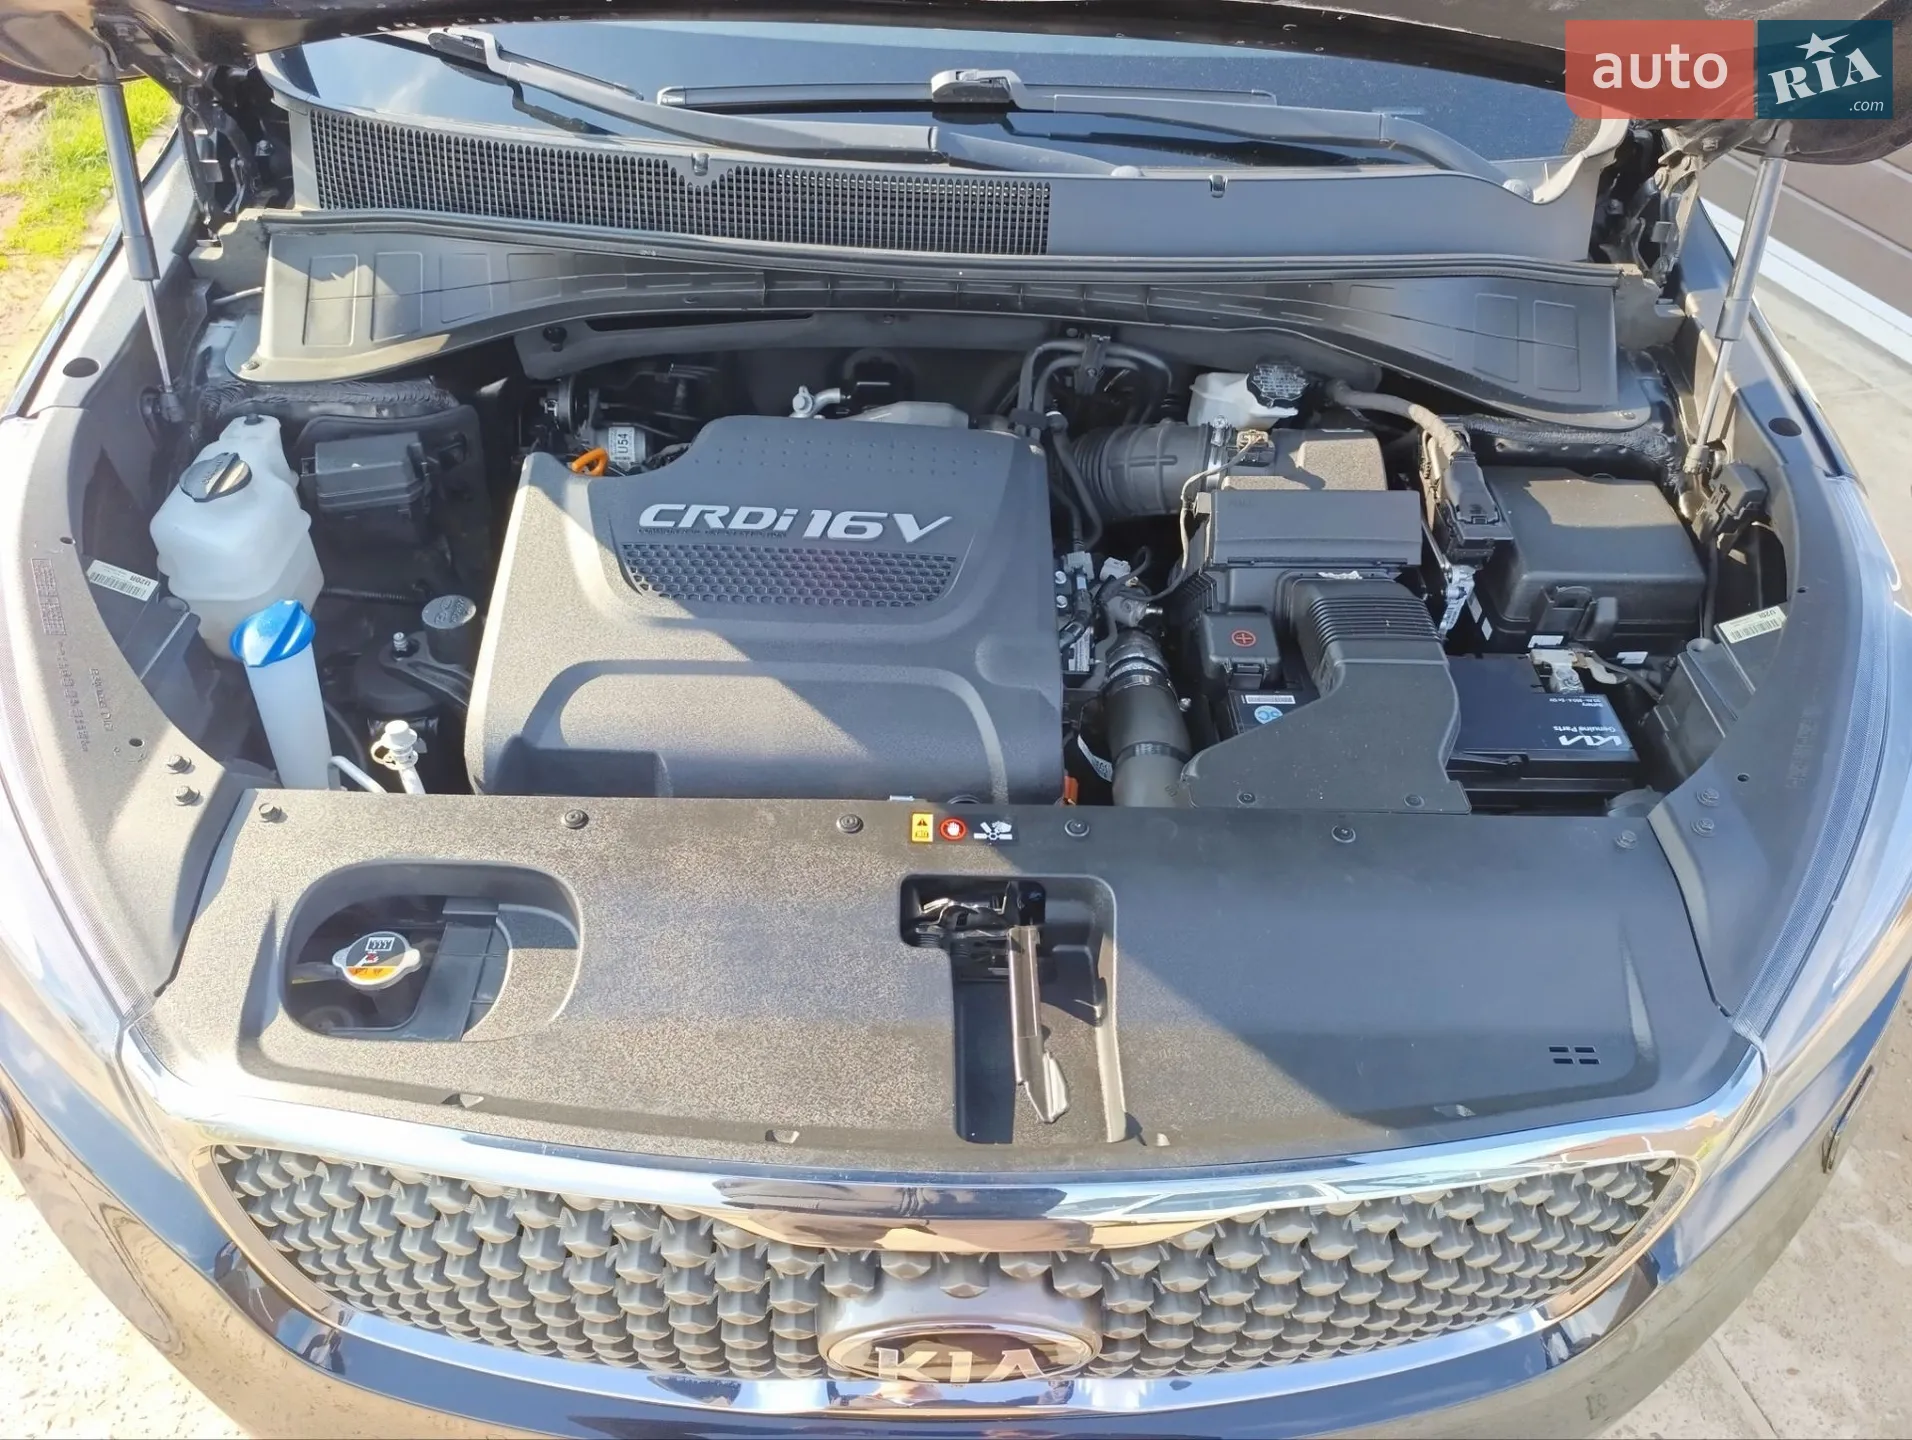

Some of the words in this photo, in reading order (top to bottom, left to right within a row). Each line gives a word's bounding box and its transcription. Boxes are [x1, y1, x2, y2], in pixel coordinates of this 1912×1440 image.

[616, 432, 629, 455] U54
[638, 502, 799, 532] CRDi
[802, 508, 953, 544] 16V
[1552, 725, 1578, 733] Parts
[1578, 725, 1616, 733] Genuine
[1558, 734, 1623, 746] KIA
[875, 1346, 1047, 1384] KIA
